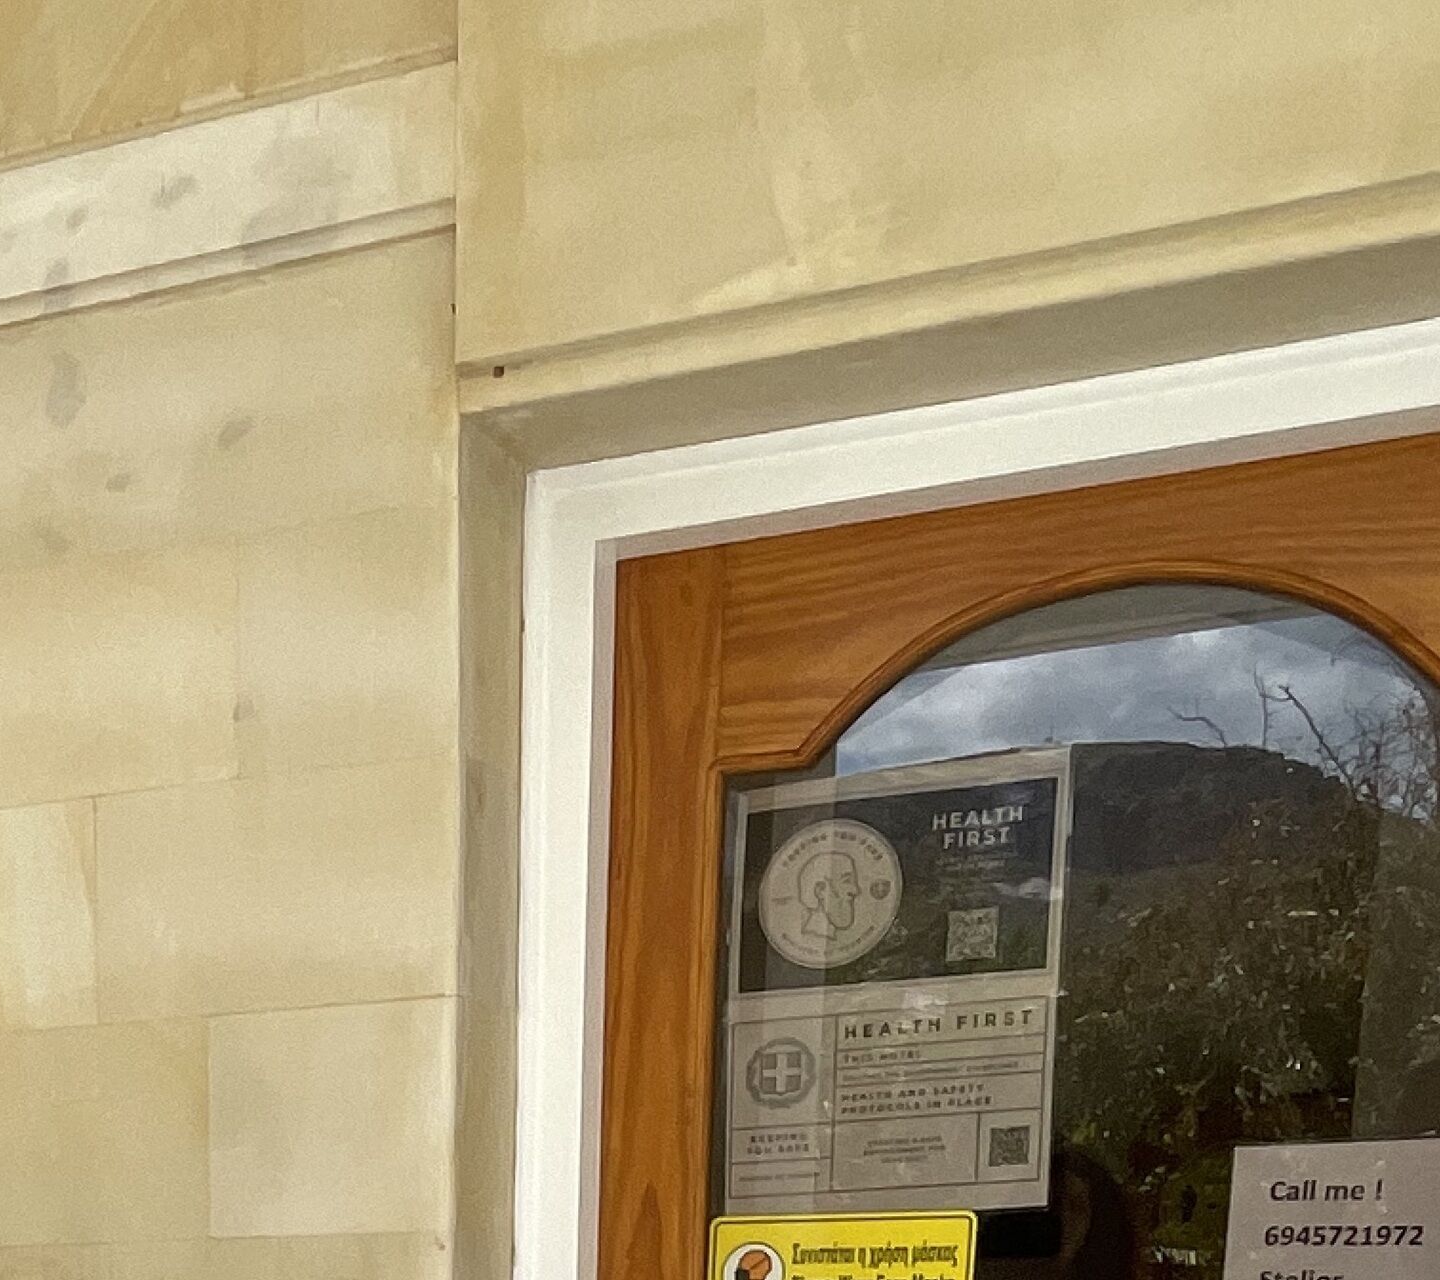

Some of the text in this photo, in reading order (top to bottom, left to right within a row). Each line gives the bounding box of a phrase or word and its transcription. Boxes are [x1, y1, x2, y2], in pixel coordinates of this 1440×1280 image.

[932, 806, 1023, 831] HEALTH
[943, 827, 1010, 849] FIRST
[844, 1010, 1032, 1039] HEALTH FIRST
[1269, 1179, 1318, 1201] Call
[1324, 1184, 1366, 1201] me
[1264, 1225, 1425, 1247] 6945721972
